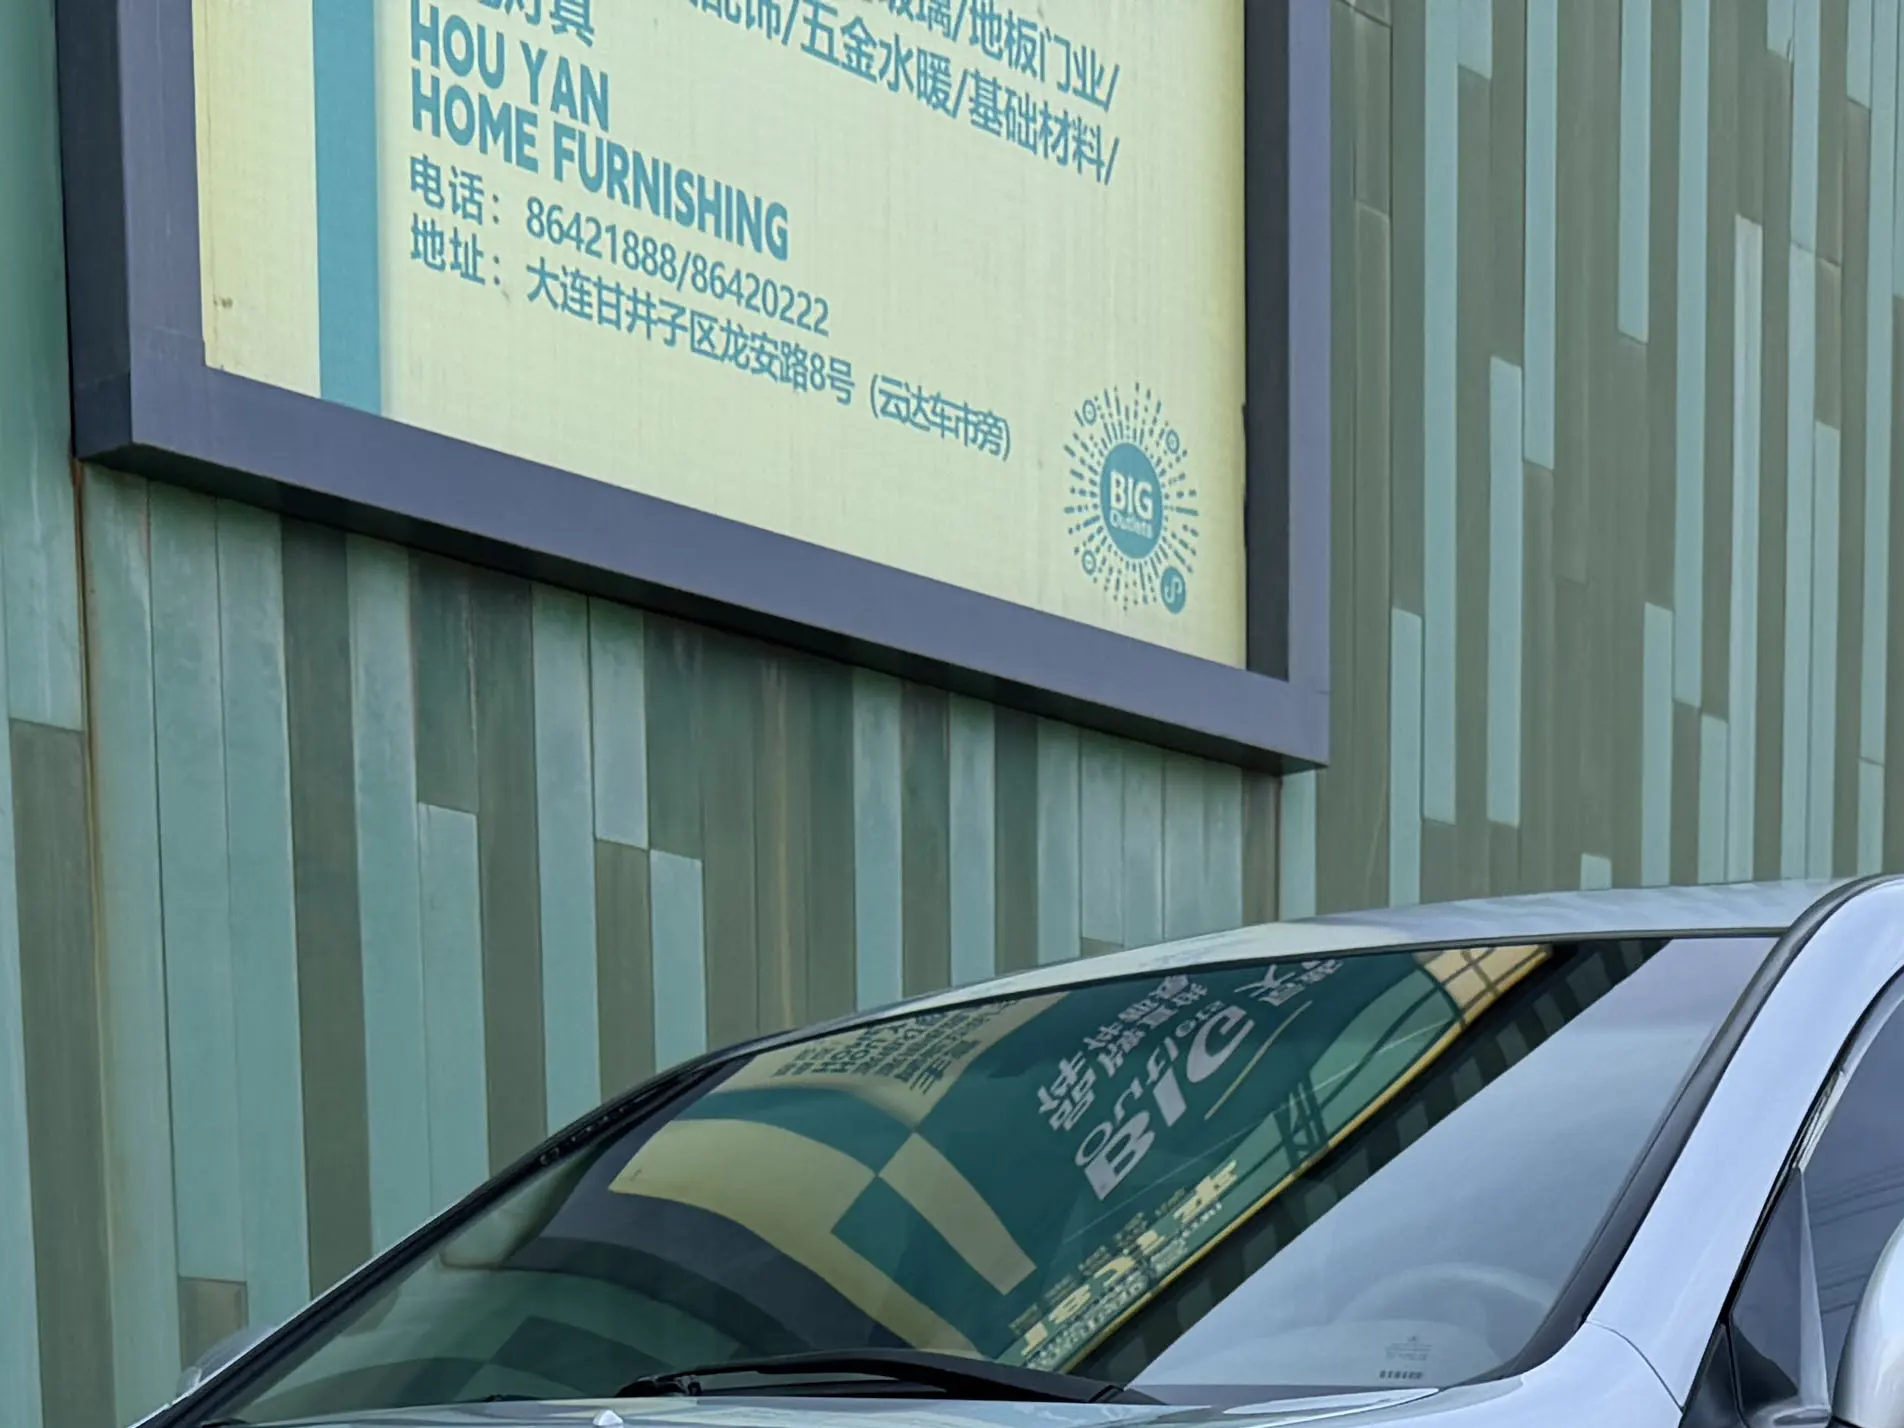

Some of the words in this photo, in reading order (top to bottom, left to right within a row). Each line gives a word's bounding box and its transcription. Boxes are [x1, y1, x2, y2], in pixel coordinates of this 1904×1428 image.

[411, 0, 505, 89] HOU
[520, 40, 609, 132] YAN
[411, 67, 539, 174] HOME
[553, 120, 789, 261] FURNISHING
[526, 196, 830, 337] 86421888/86420222
[526, 256, 855, 406] 大连甘井子区龙安路8号
[1109, 469, 1153, 521] BIG
